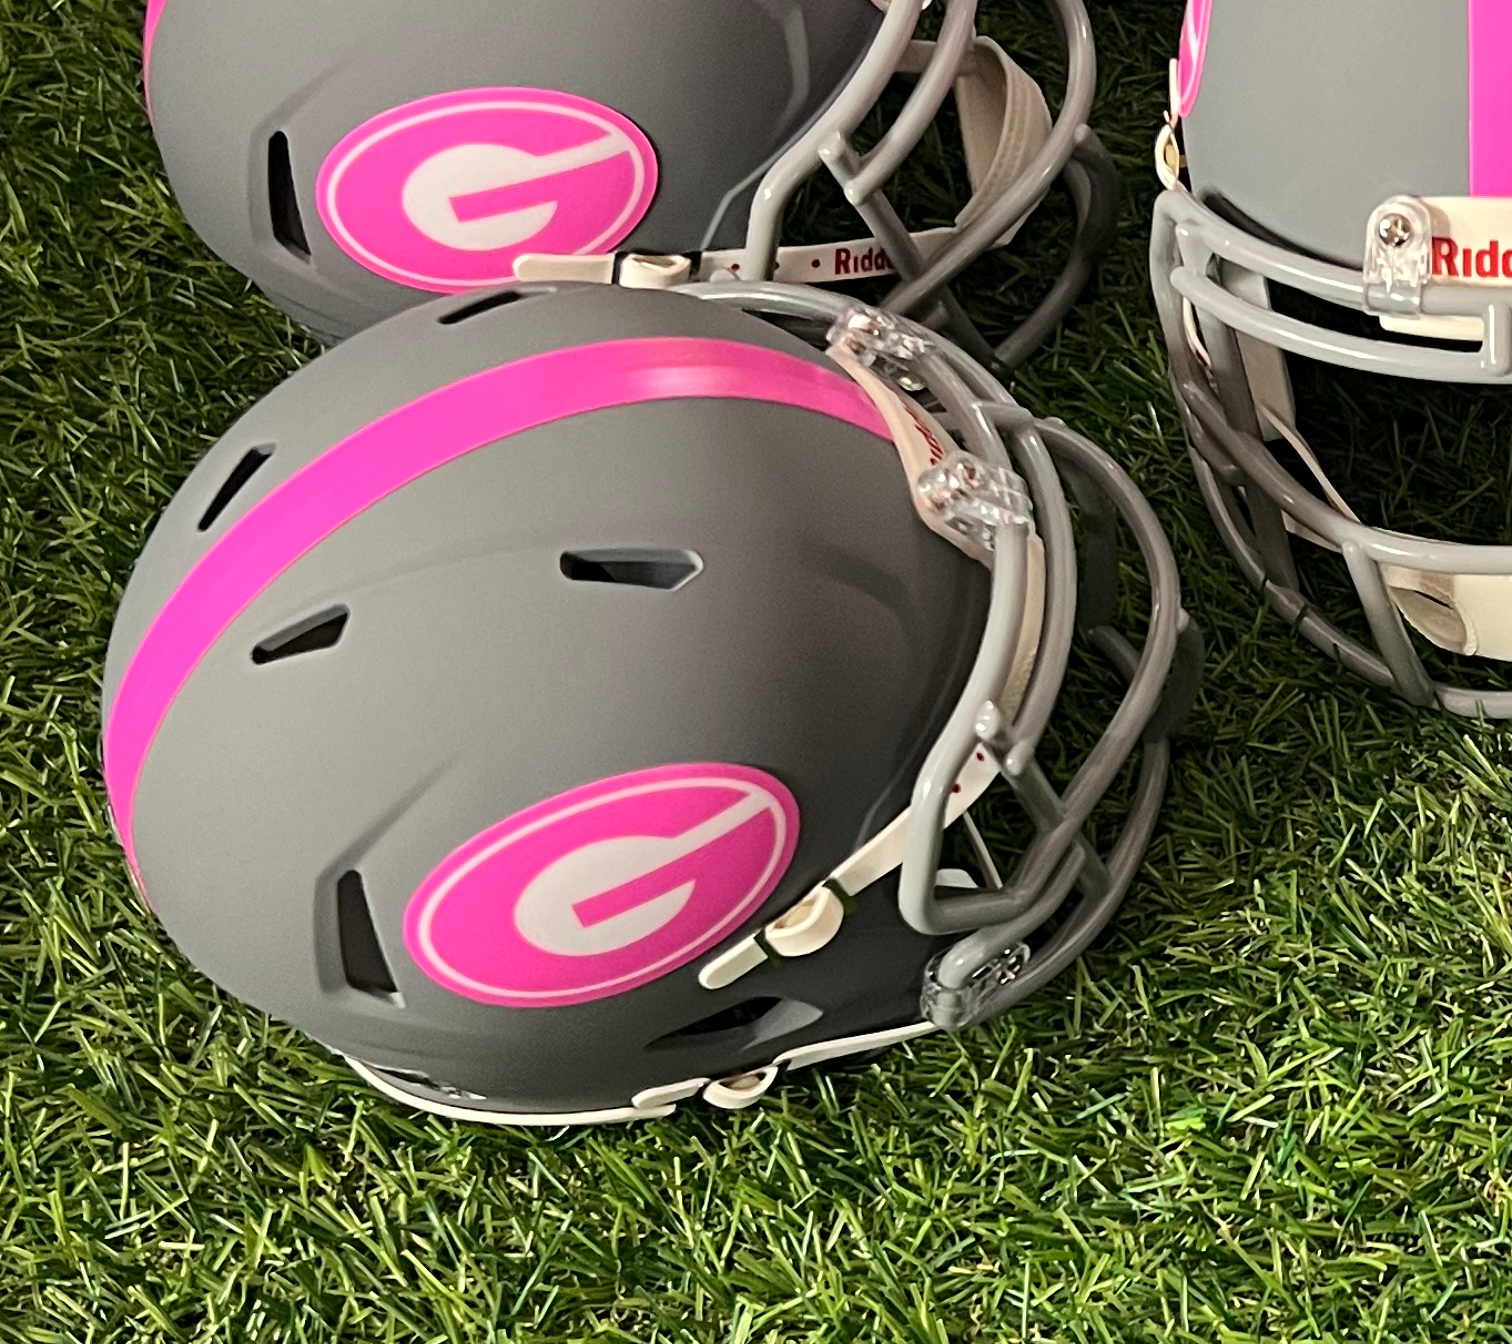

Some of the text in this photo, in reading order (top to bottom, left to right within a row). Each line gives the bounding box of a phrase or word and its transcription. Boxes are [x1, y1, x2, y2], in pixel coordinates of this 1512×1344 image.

[402, 143, 632, 251] G
[834, 247, 895, 275] Ridd
[514, 789, 773, 956] G
